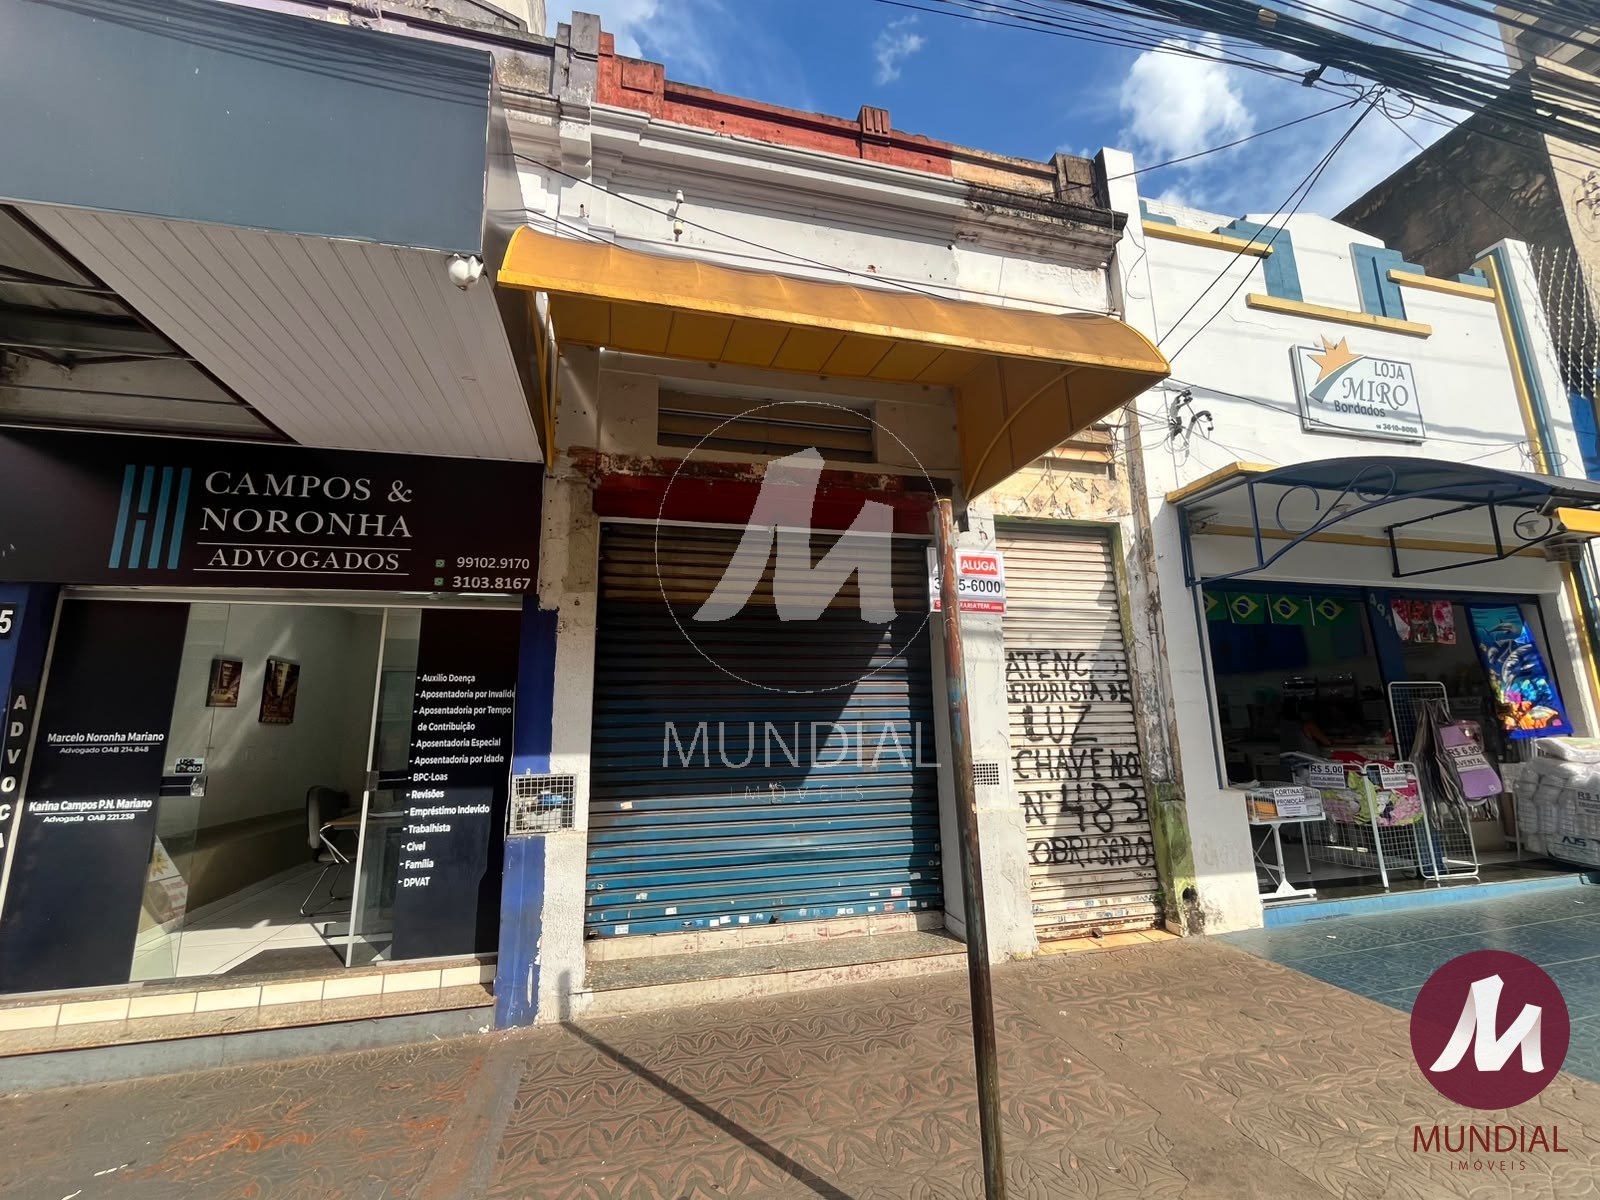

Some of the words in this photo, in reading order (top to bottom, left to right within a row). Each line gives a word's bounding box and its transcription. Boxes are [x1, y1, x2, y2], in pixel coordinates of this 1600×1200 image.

[1374, 361, 1406, 380] LOJA
[1342, 377, 1409, 410] MIRO
[1334, 400, 1386, 417] Bordados
[205, 471, 371, 501] CAMPOS
[388, 480, 412, 502] &
[200, 507, 412, 538] NORONHA
[208, 548, 399, 570] ADVOGADOS
[457, 557, 530, 570] 99102.9170
[961, 561, 996, 571] ALUGA
[452, 576, 531, 590] 3103.8167
[449, 674, 476, 684] Doença
[420, 690, 474, 700] Aposentadoria
[475, 691, 487, 700] por
[419, 706, 472, 716] Aposentadoria
[473, 707, 486, 716] por
[487, 706, 512, 715] Tempo
[417, 723, 427, 731] de
[428, 722, 476, 732] Contribuição
[1023, 704, 1098, 743] LUZ
[47, 733, 85, 743] Marcelo
[86, 732, 126, 742] Noronha
[127, 731, 165, 742] Mariano
[416, 738, 470, 749] Aposentadoria
[471, 738, 501, 748] Especial
[414, 755, 469, 766] Aposentadoria
[470, 756, 483, 765] por
[484, 754, 504, 763] Idade
[1016, 748, 1104, 781] CHAVE
[1111, 749, 1141, 780] NO
[1324, 765, 1343, 774] 5,00
[411, 789, 444, 799] Revisões
[29, 801, 59, 811] Karina
[61, 800, 97, 811] Campos
[116, 798, 152, 809] Mariano
[410, 806, 456, 817] Empréstimo
[457, 804, 490, 814] Indevido
[1060, 782, 1143, 833] 483
[43, 816, 84, 824] Advogada
[408, 823, 451, 834] Trabalhista
[1032, 835, 1151, 868] OBRIGADO
[403, 877, 431, 887] DPVAT
